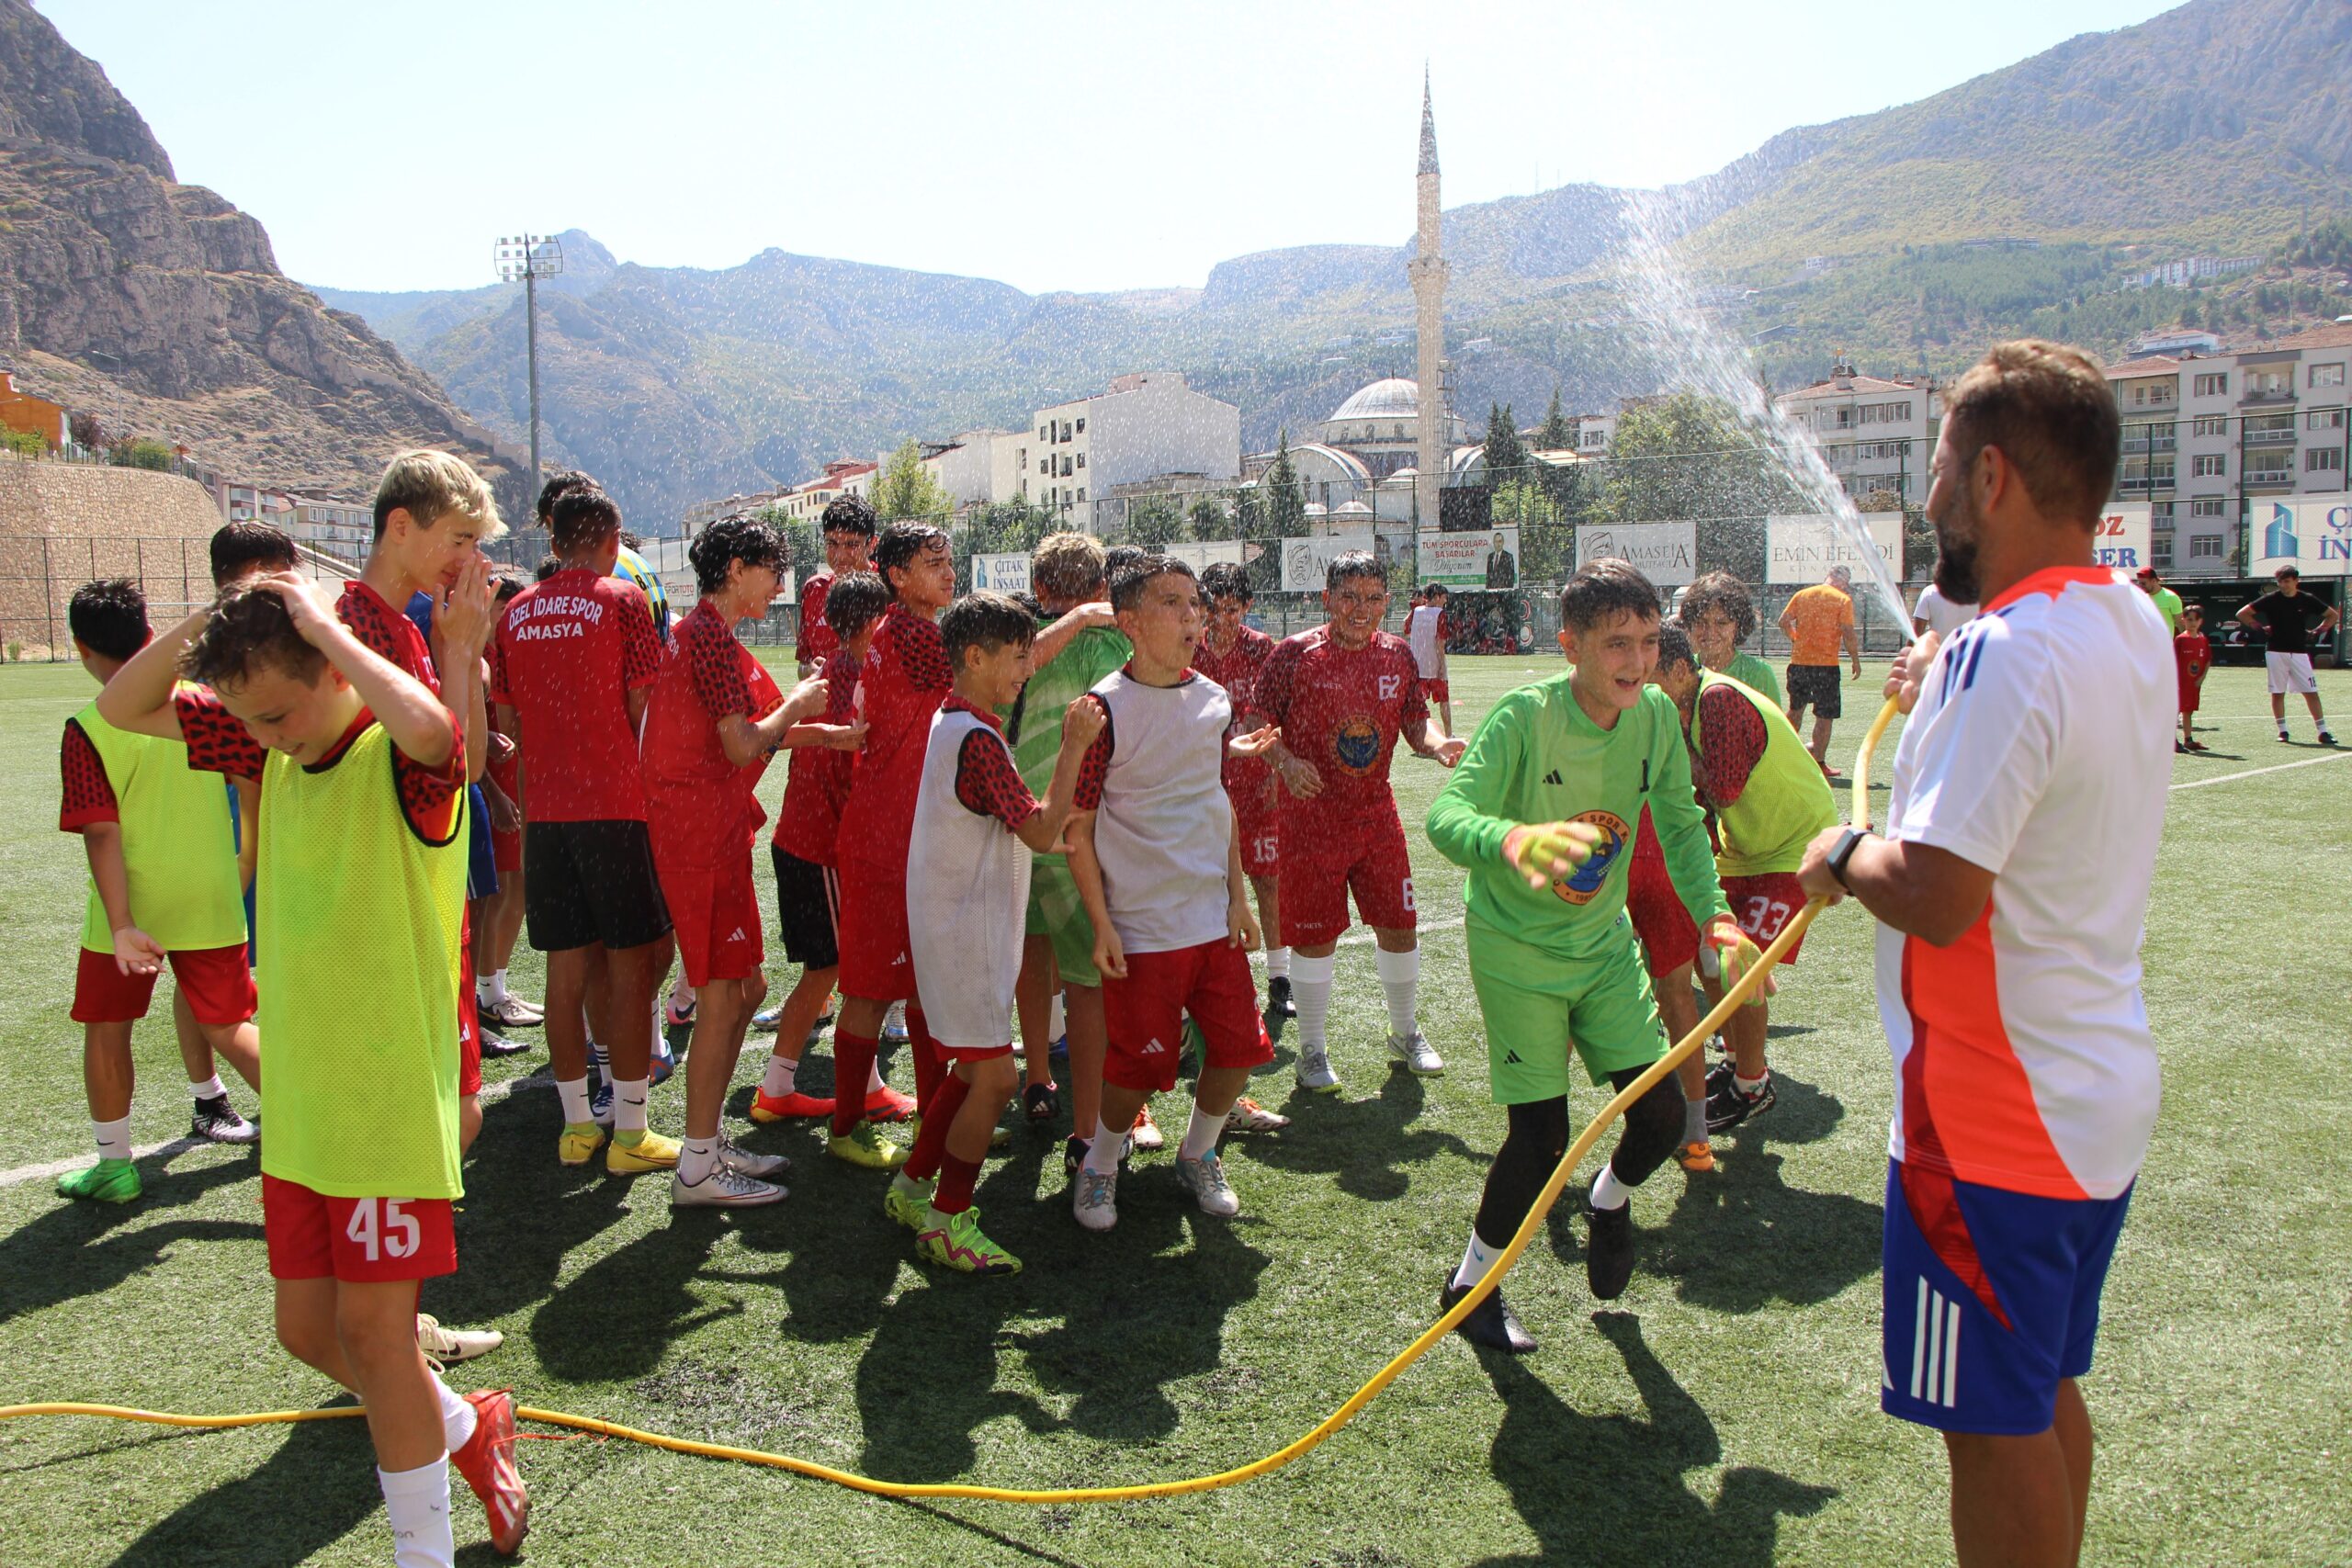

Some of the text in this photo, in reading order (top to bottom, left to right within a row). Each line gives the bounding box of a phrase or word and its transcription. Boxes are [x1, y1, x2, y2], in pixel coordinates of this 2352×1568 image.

[1440, 538, 1488, 549] SPORCULARA
[1773, 543, 1893, 562] EMİN EFEDİ
[509, 595, 603, 631] ÖZEL İDARE SPOR
[516, 622, 583, 641] AMASYA
[1378, 674, 1400, 700] 62
[1639, 759, 1649, 794] 1
[1589, 814, 1621, 830] SPOR
[1252, 837, 1278, 863] 15
[1738, 896, 1791, 941] 33
[346, 1197, 420, 1261] 45
